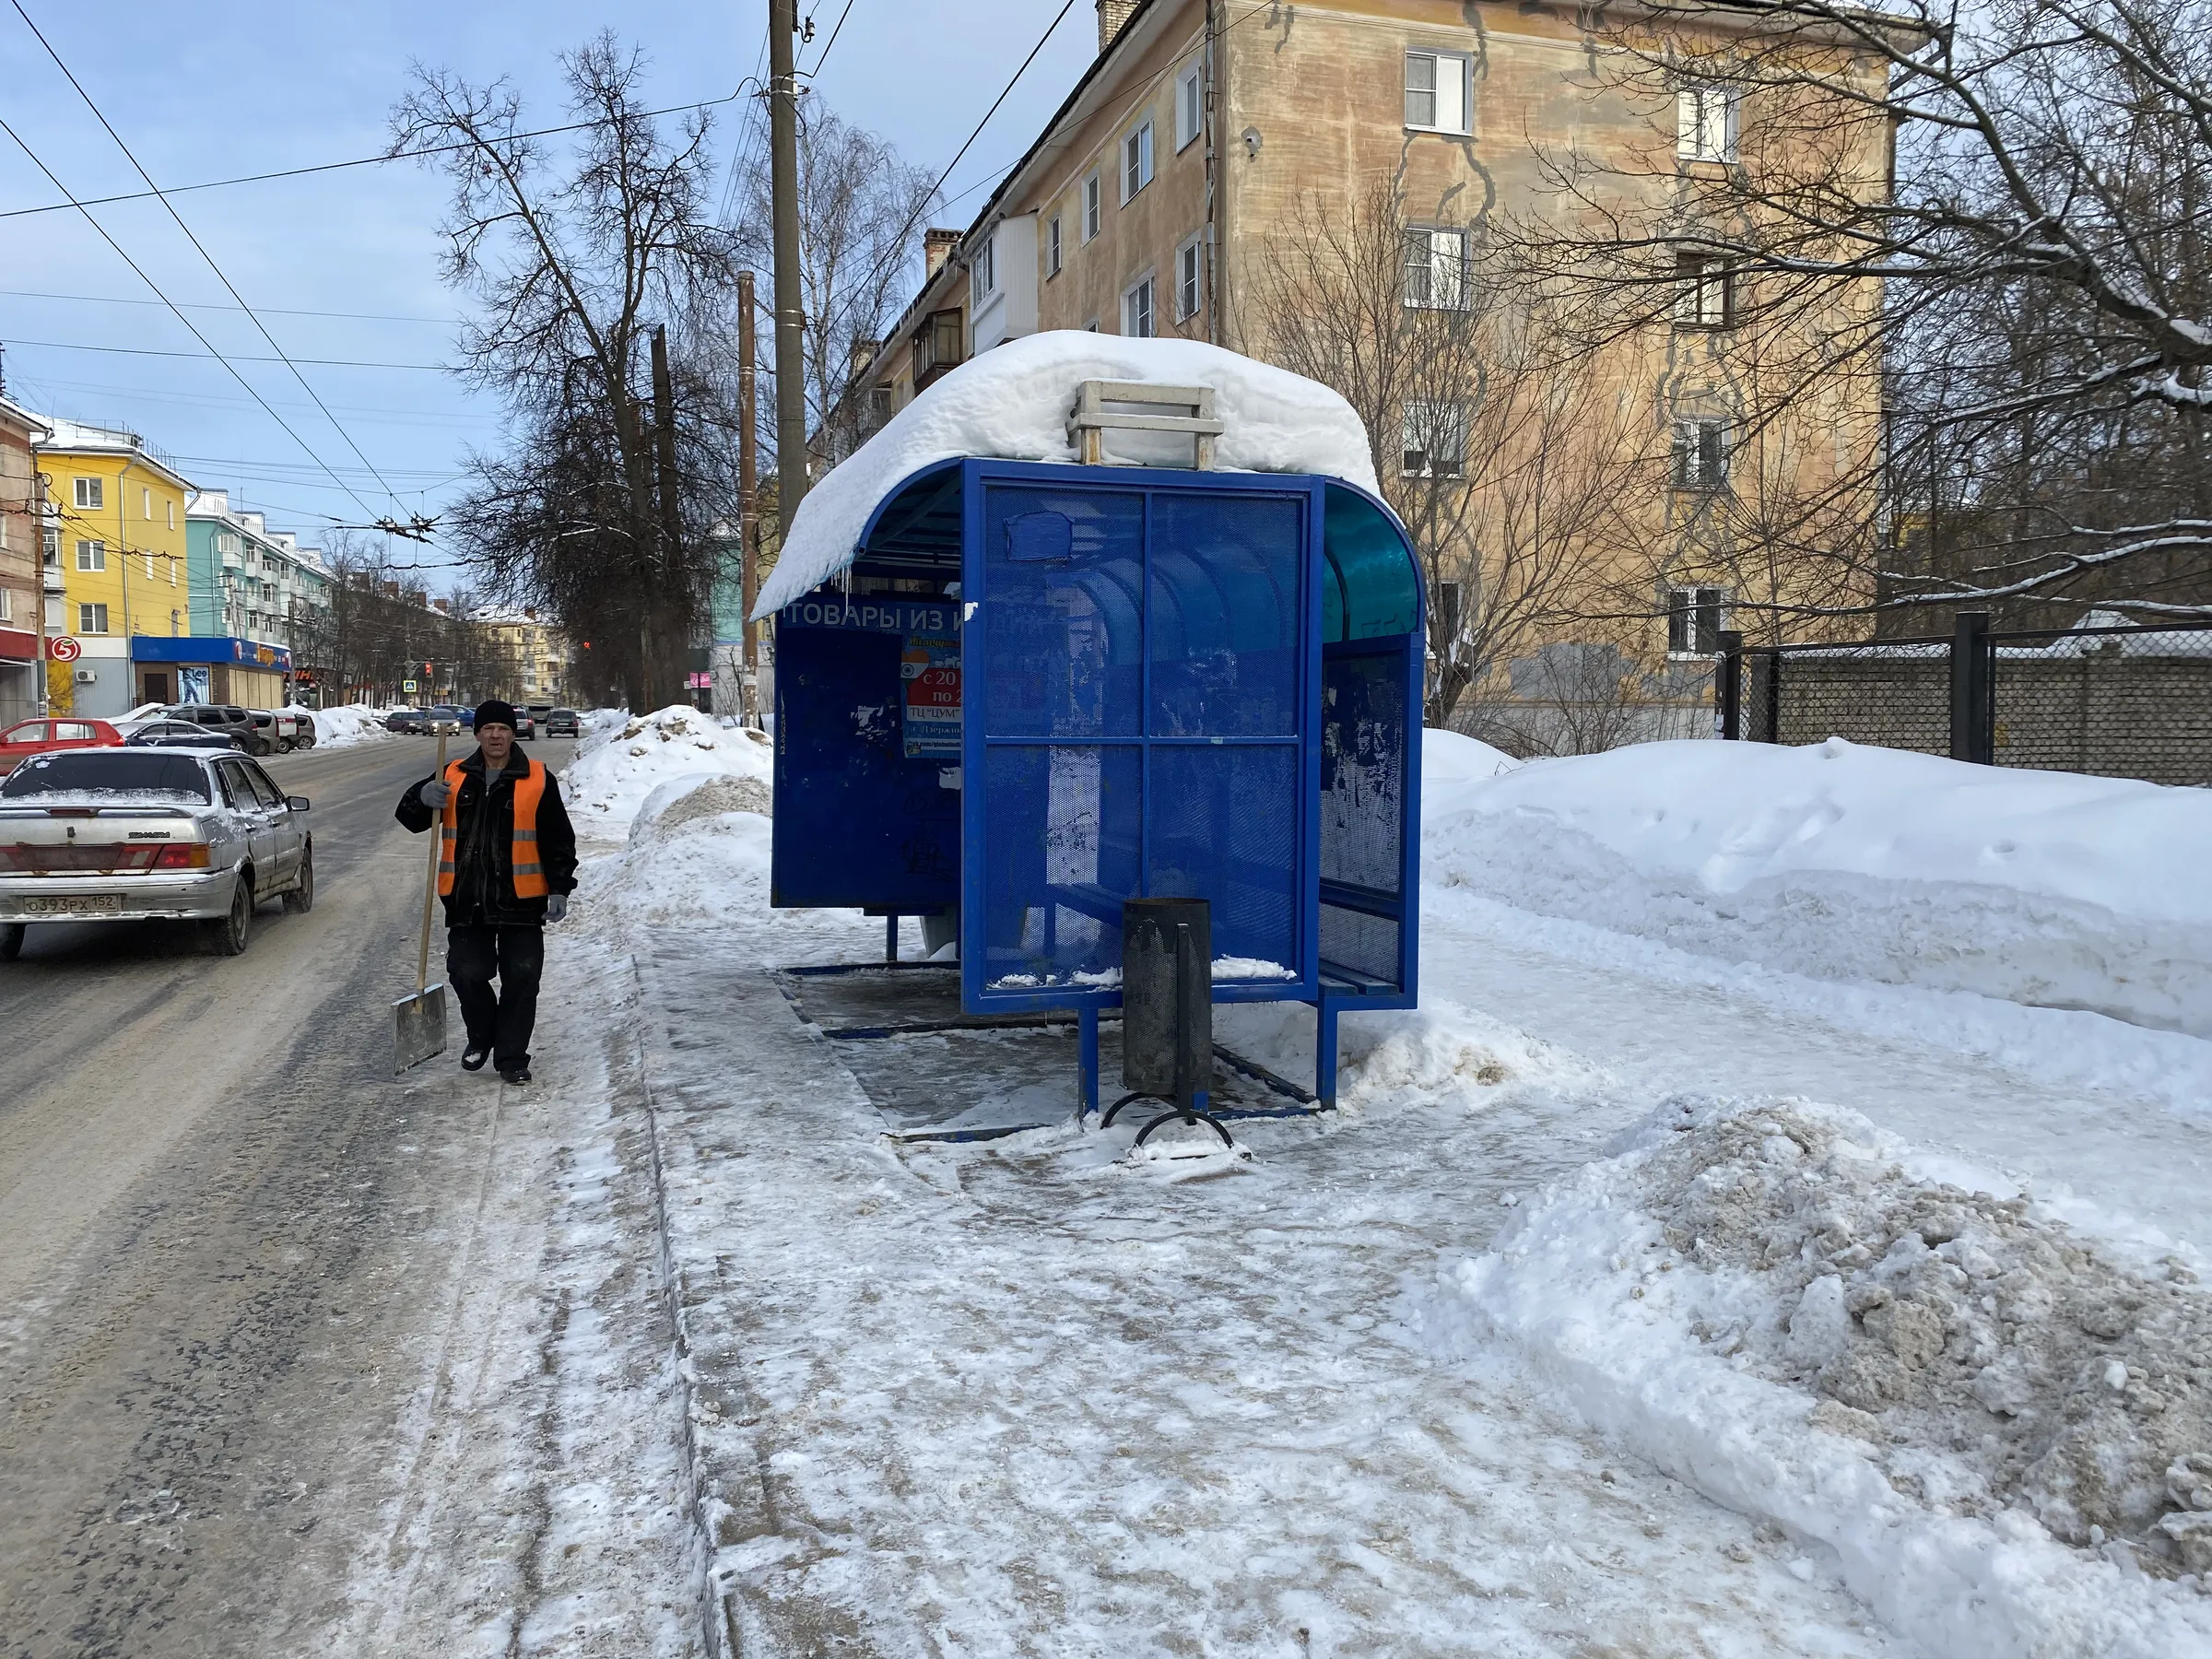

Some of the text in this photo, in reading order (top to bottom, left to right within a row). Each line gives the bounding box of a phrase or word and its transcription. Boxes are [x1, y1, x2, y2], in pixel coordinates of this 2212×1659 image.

[788, 602, 900, 629] ТОВАРЫ
[910, 608, 944, 631] ИЗ
[193, 668, 206, 677] Lee
[935, 671, 956, 686] 20
[932, 690, 951, 702] по
[911, 707, 925, 719] ТЦ
[91, 896, 113, 906] 152
